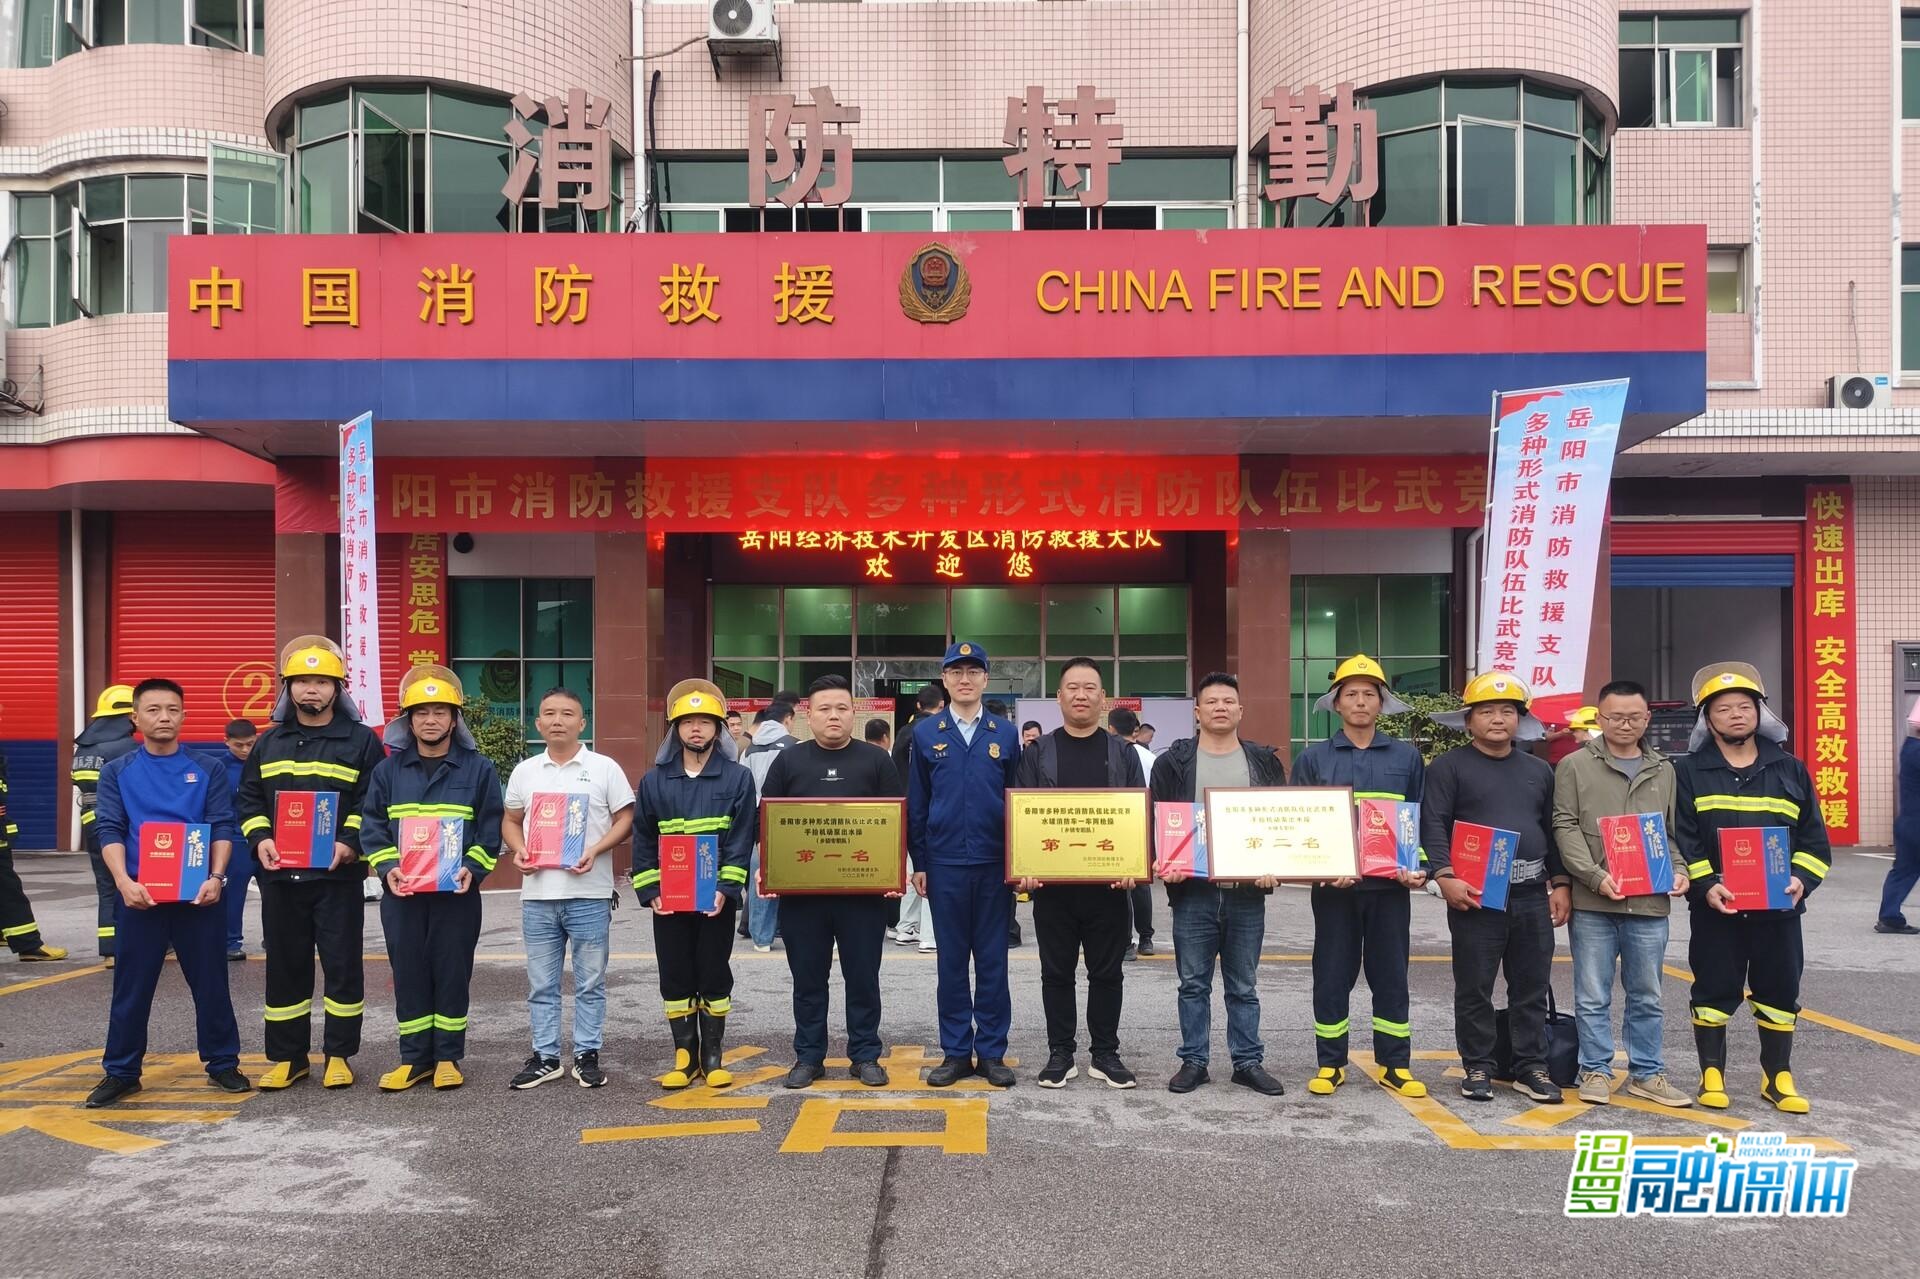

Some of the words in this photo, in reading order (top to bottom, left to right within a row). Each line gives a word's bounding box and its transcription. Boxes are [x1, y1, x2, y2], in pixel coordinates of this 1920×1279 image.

[502, 83, 1379, 210] 消防特勤
[189, 262, 836, 329] 中国消防救援
[1036, 269, 1193, 314] CHINA
[1209, 267, 1322, 311] FIRE
[1338, 265, 1445, 309] AND
[1471, 262, 1687, 307] RESCUE
[739, 529, 1162, 551] 岳阳经济技术开发区消防救援大队
[866, 552, 1033, 577] 欢迎您
[1532, 407, 1593, 687] 岳阳市消防救援支队
[1812, 491, 1847, 618] 快速出库
[408, 532, 441, 634] 居安思危
[1814, 636, 1849, 829] 安全高效救援
[796, 849, 870, 863] 第一名
[1041, 838, 1115, 852] 第一名
[1245, 836, 1320, 849] 第二名
